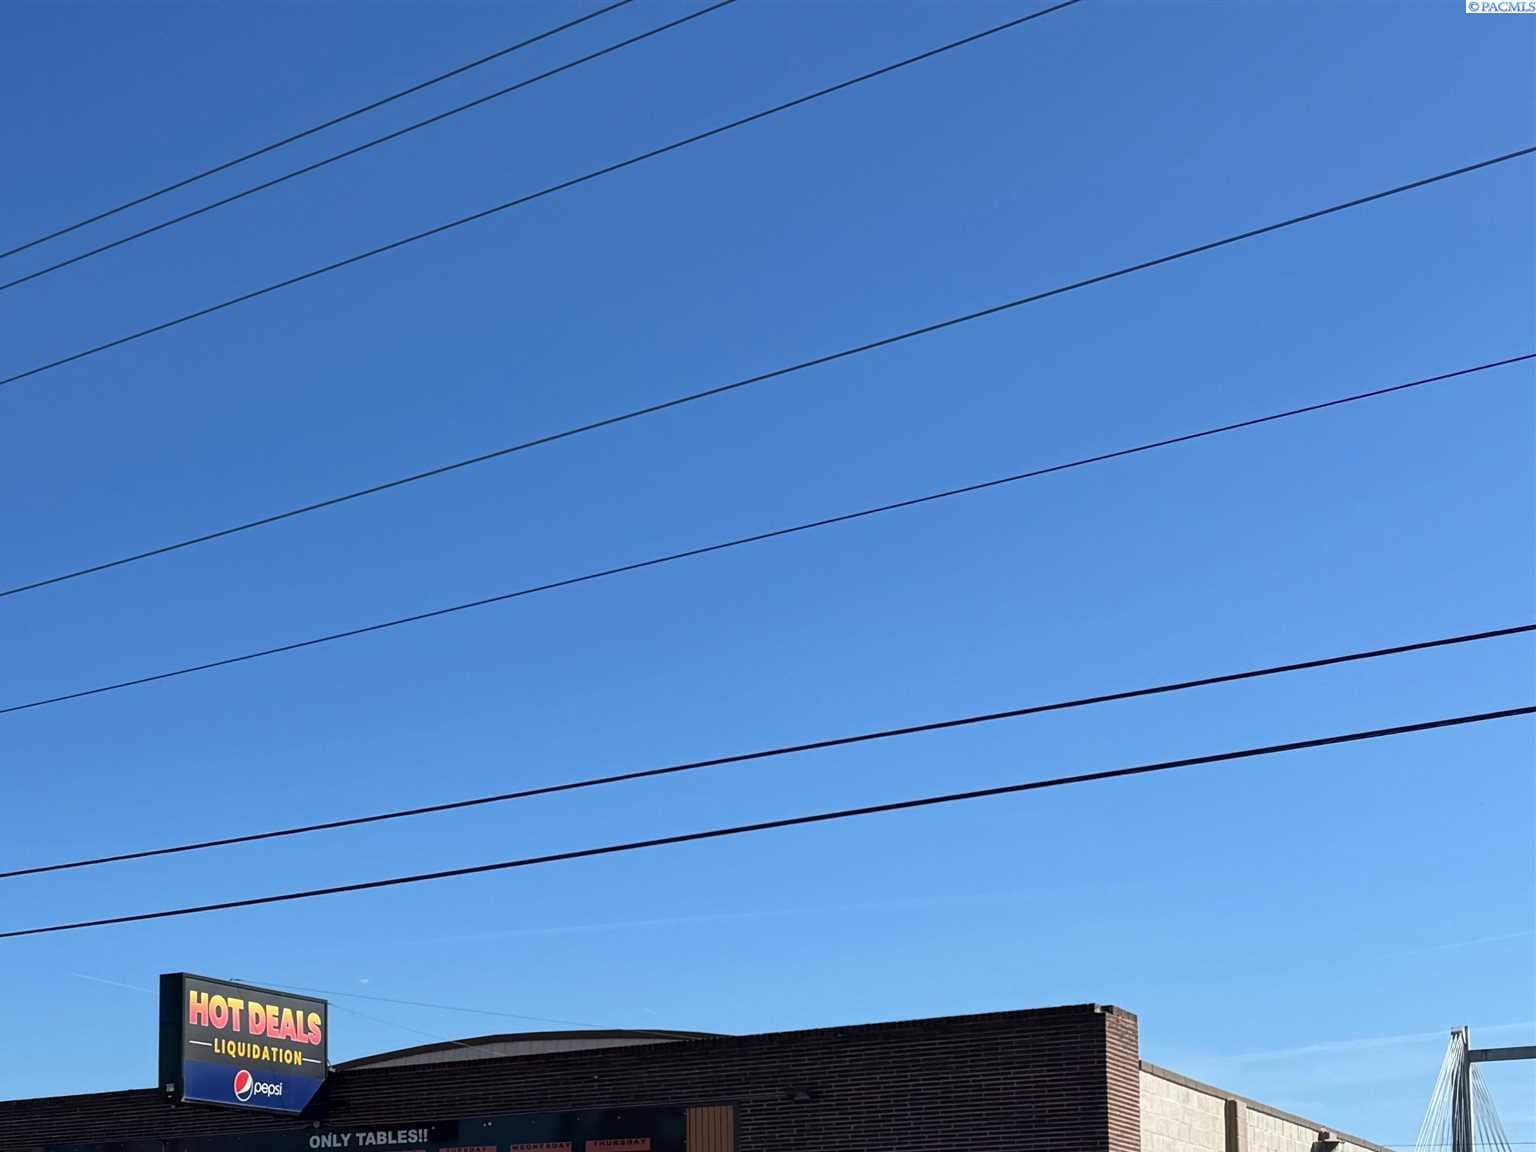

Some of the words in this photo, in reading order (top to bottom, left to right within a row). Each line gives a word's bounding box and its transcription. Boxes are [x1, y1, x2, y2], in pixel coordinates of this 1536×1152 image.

[189, 990, 244, 1032] HOT
[248, 1001, 322, 1046] DEALS
[214, 1037, 302, 1066] LIQUIDATION
[254, 1082, 283, 1098] pepsi
[309, 1131, 352, 1149] ONLY
[355, 1128, 429, 1147] TABLES!!
[593, 1137, 647, 1147] THURSDAY
